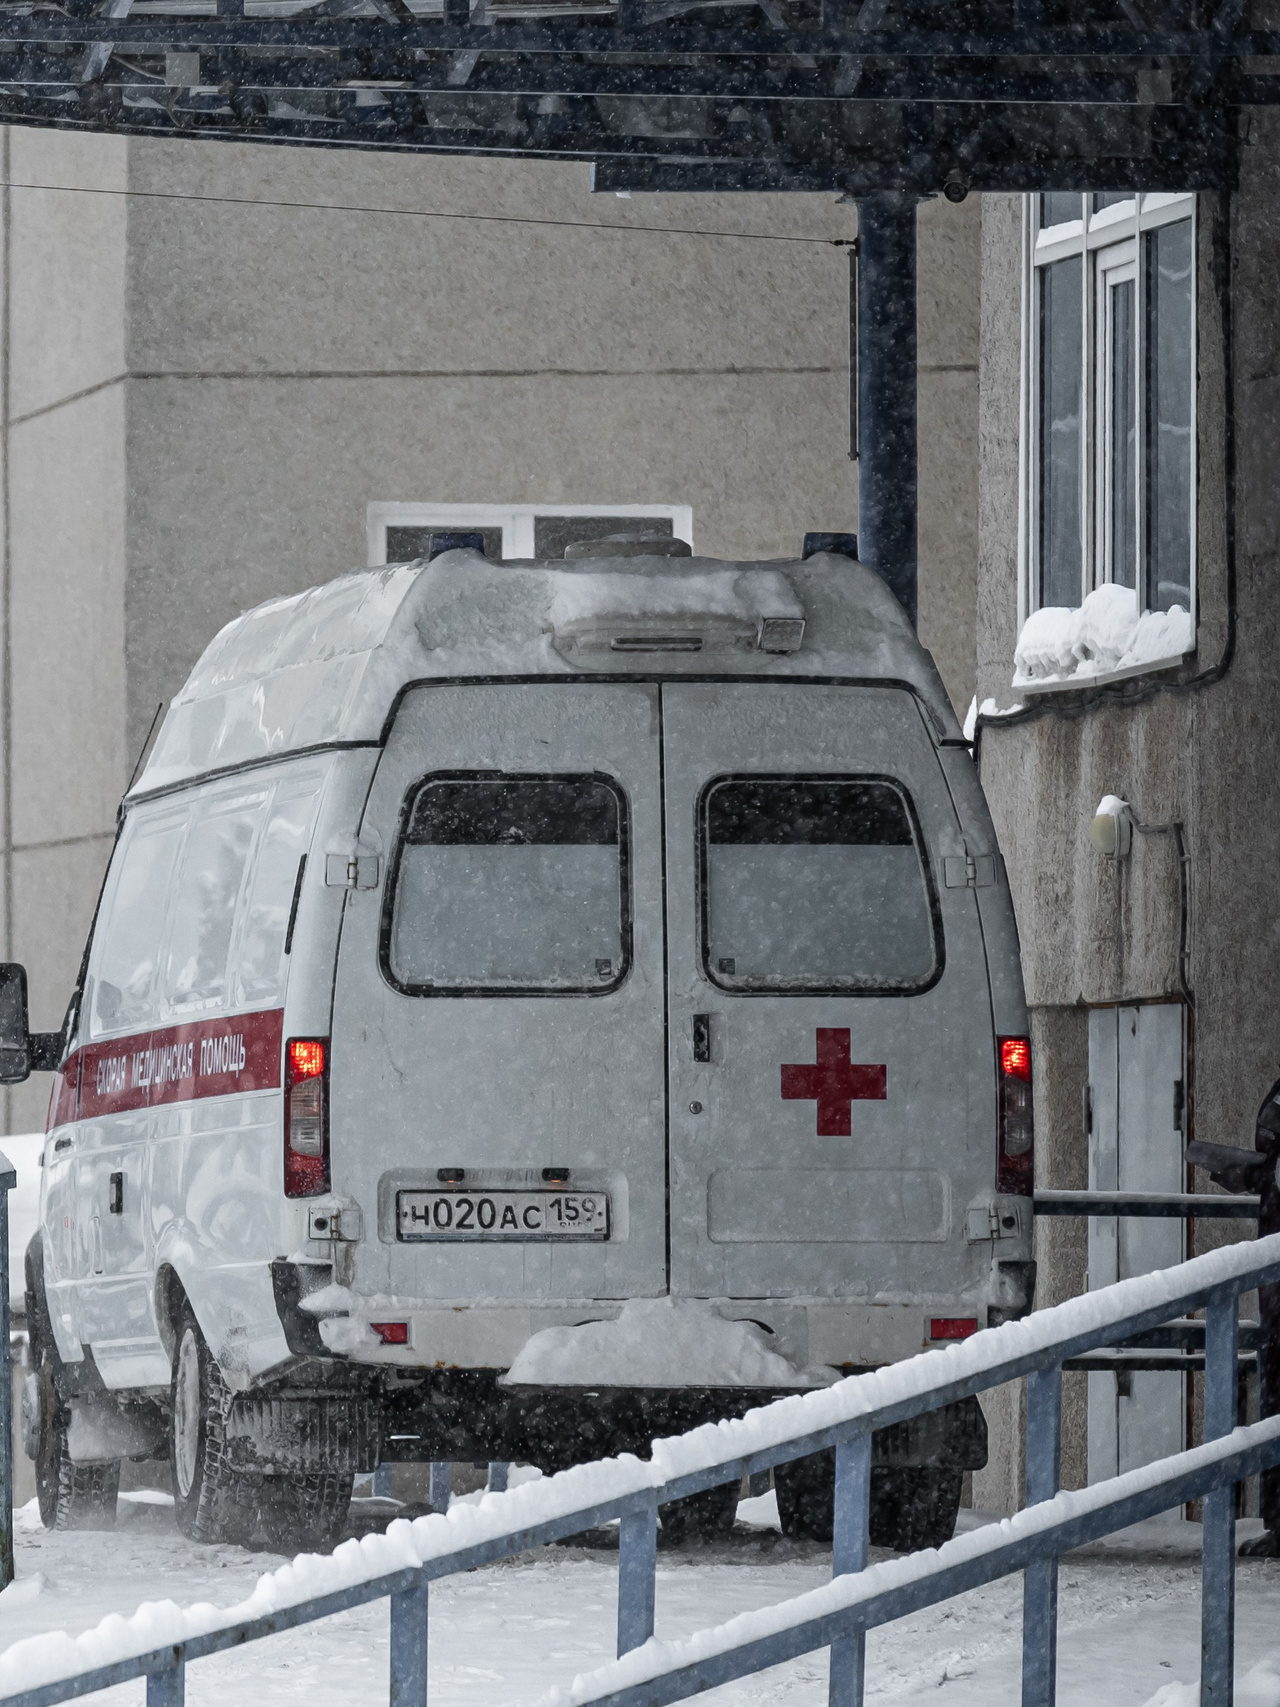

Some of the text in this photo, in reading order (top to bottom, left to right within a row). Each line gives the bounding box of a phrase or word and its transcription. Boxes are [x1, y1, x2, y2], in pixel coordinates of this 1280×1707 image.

[96, 1034, 246, 1096] СКОРАЯ МЕДИЦИНСКАЯ ПОМОЩЬ
